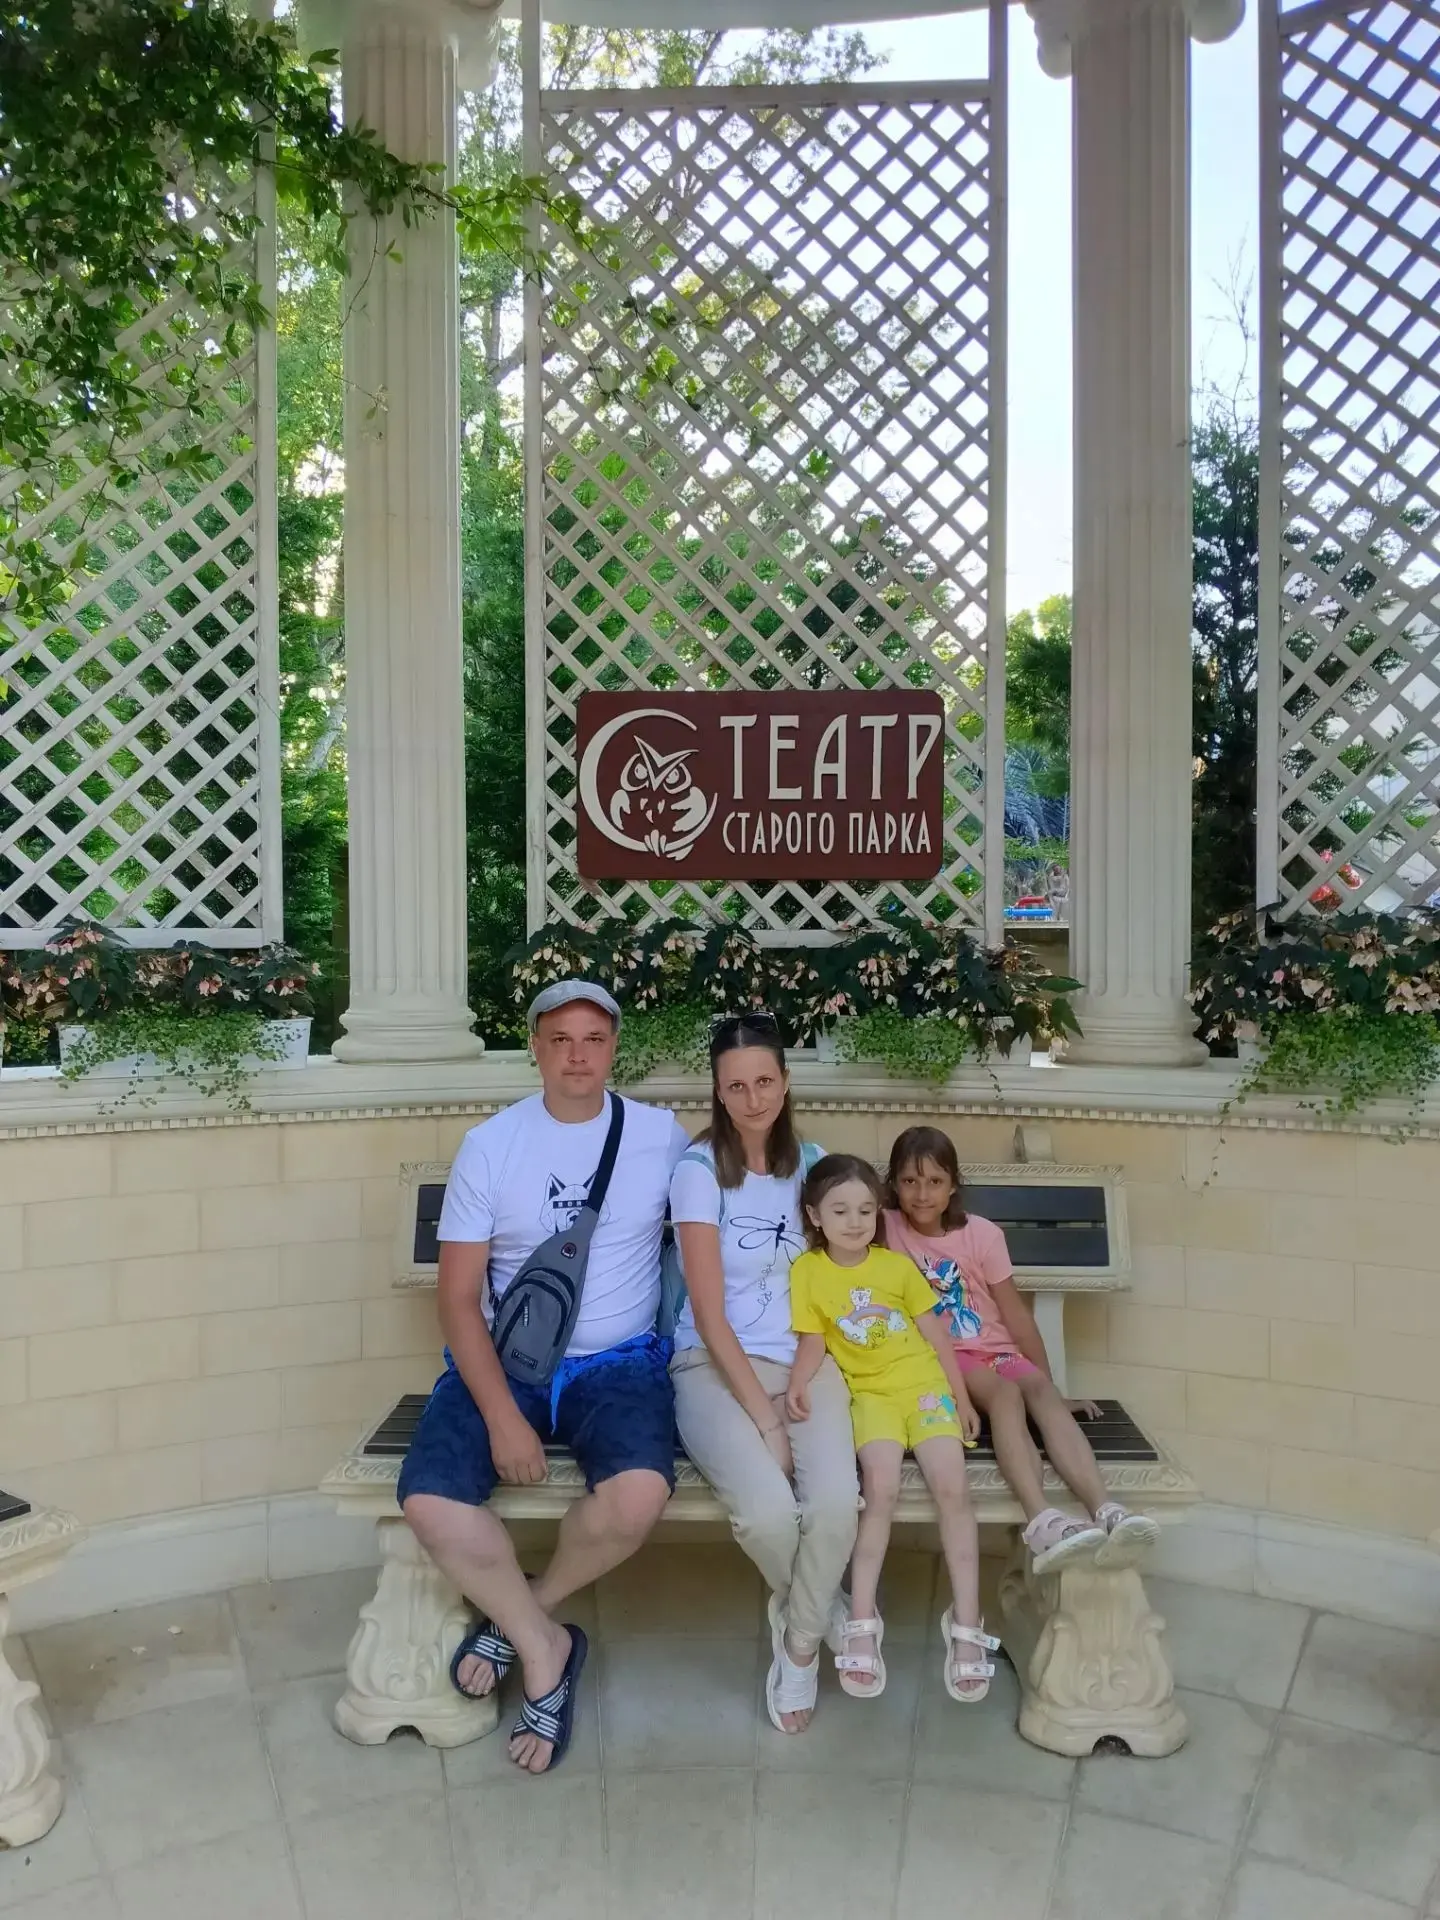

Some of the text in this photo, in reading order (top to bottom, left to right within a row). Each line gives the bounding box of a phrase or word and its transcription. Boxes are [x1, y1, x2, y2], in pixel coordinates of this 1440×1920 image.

[720, 714, 942, 800] ТЕАТР
[722, 811, 932, 854] СТАРОГО ПАРКА
